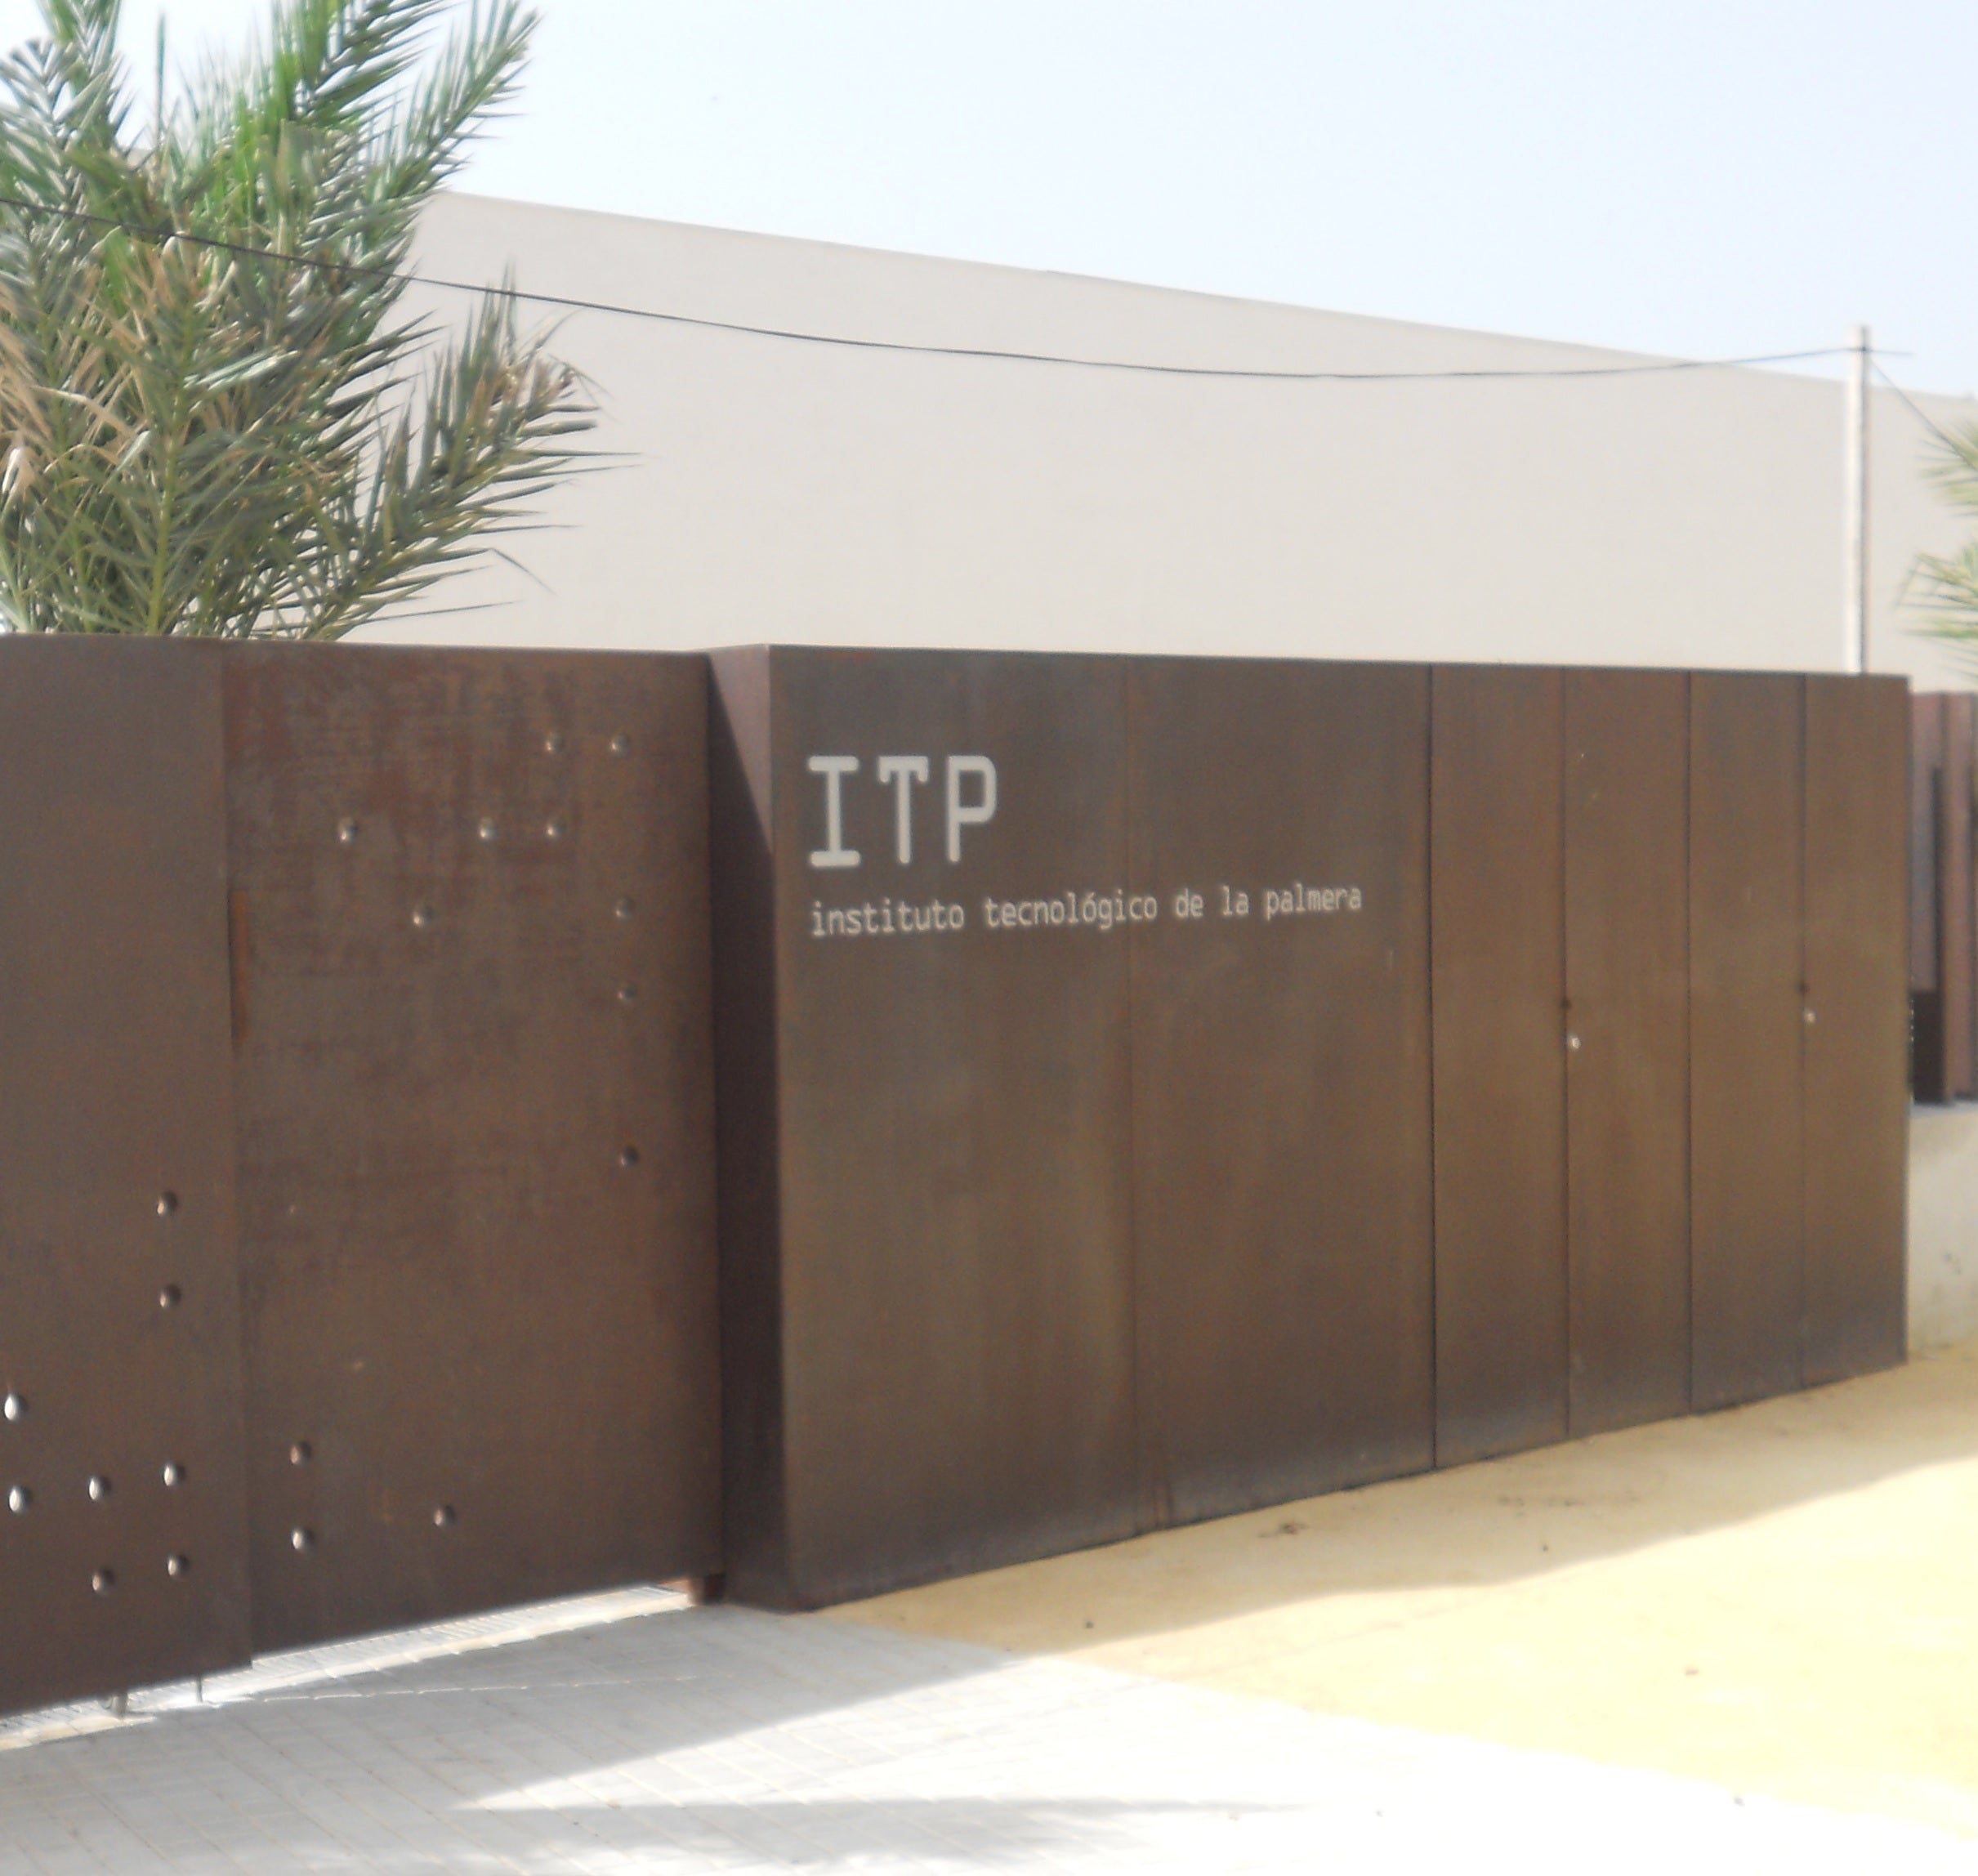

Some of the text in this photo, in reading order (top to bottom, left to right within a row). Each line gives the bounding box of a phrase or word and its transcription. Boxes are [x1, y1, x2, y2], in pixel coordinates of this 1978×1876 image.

[807, 755, 998, 869] ITP
[811, 882, 1363, 937] instituto tecnológico de la palmera
